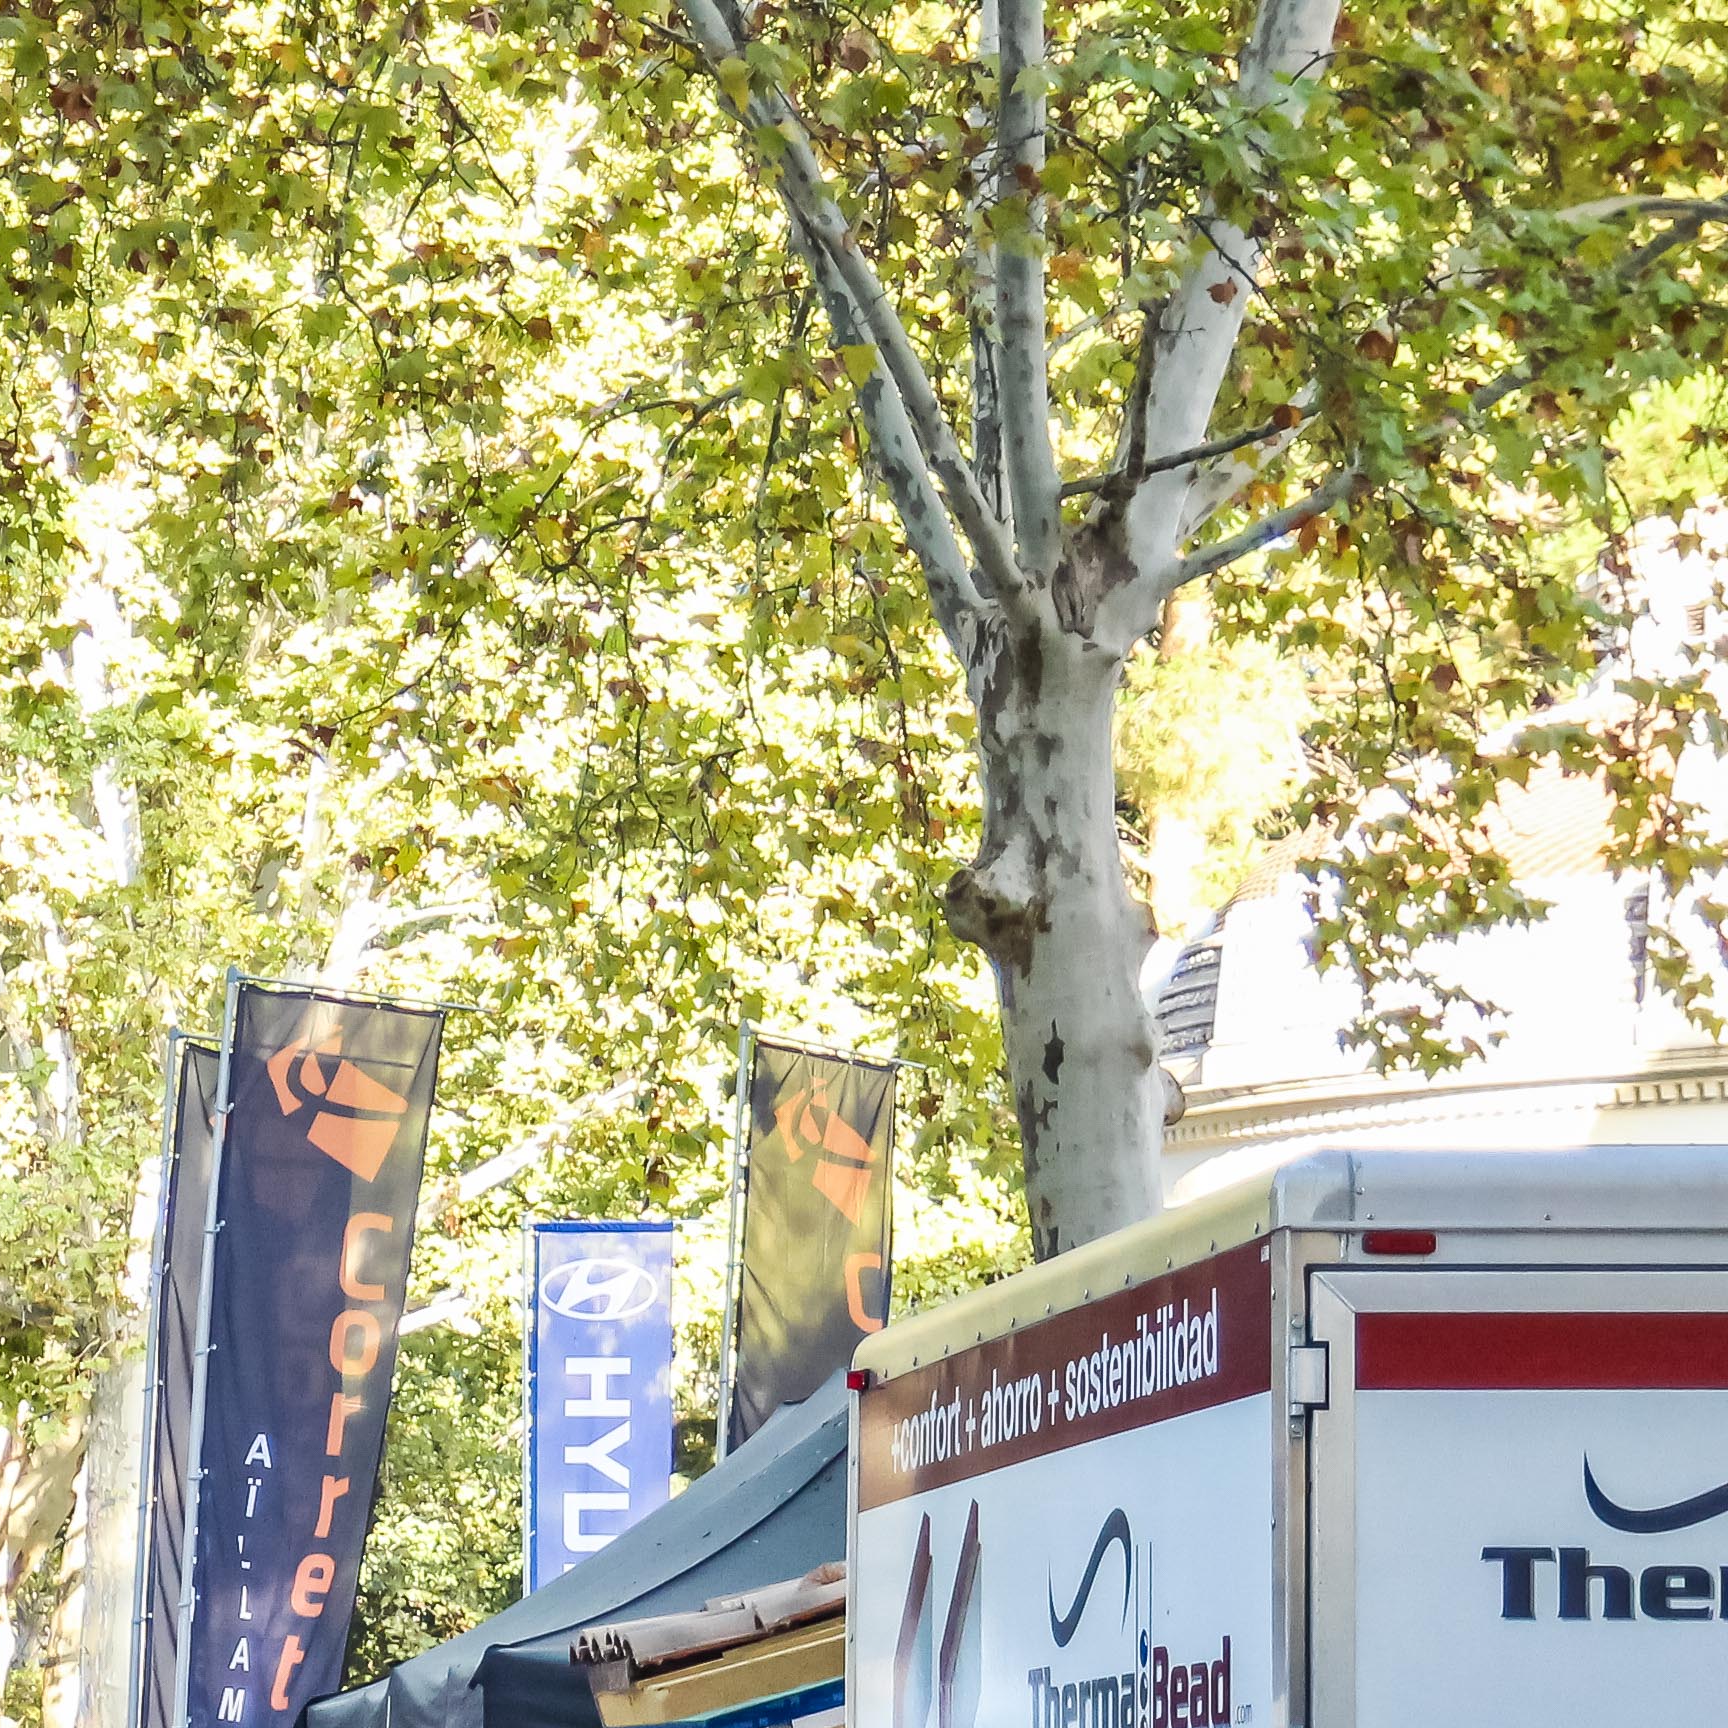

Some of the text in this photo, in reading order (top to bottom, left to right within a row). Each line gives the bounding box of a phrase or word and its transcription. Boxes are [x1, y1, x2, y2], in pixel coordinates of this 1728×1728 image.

[981, 1368, 1043, 1449] ahorro
[1065, 1288, 1220, 1423] sostenibilidad
[563, 1356, 632, 1574] HYU
[1480, 1545, 1728, 1622] The
